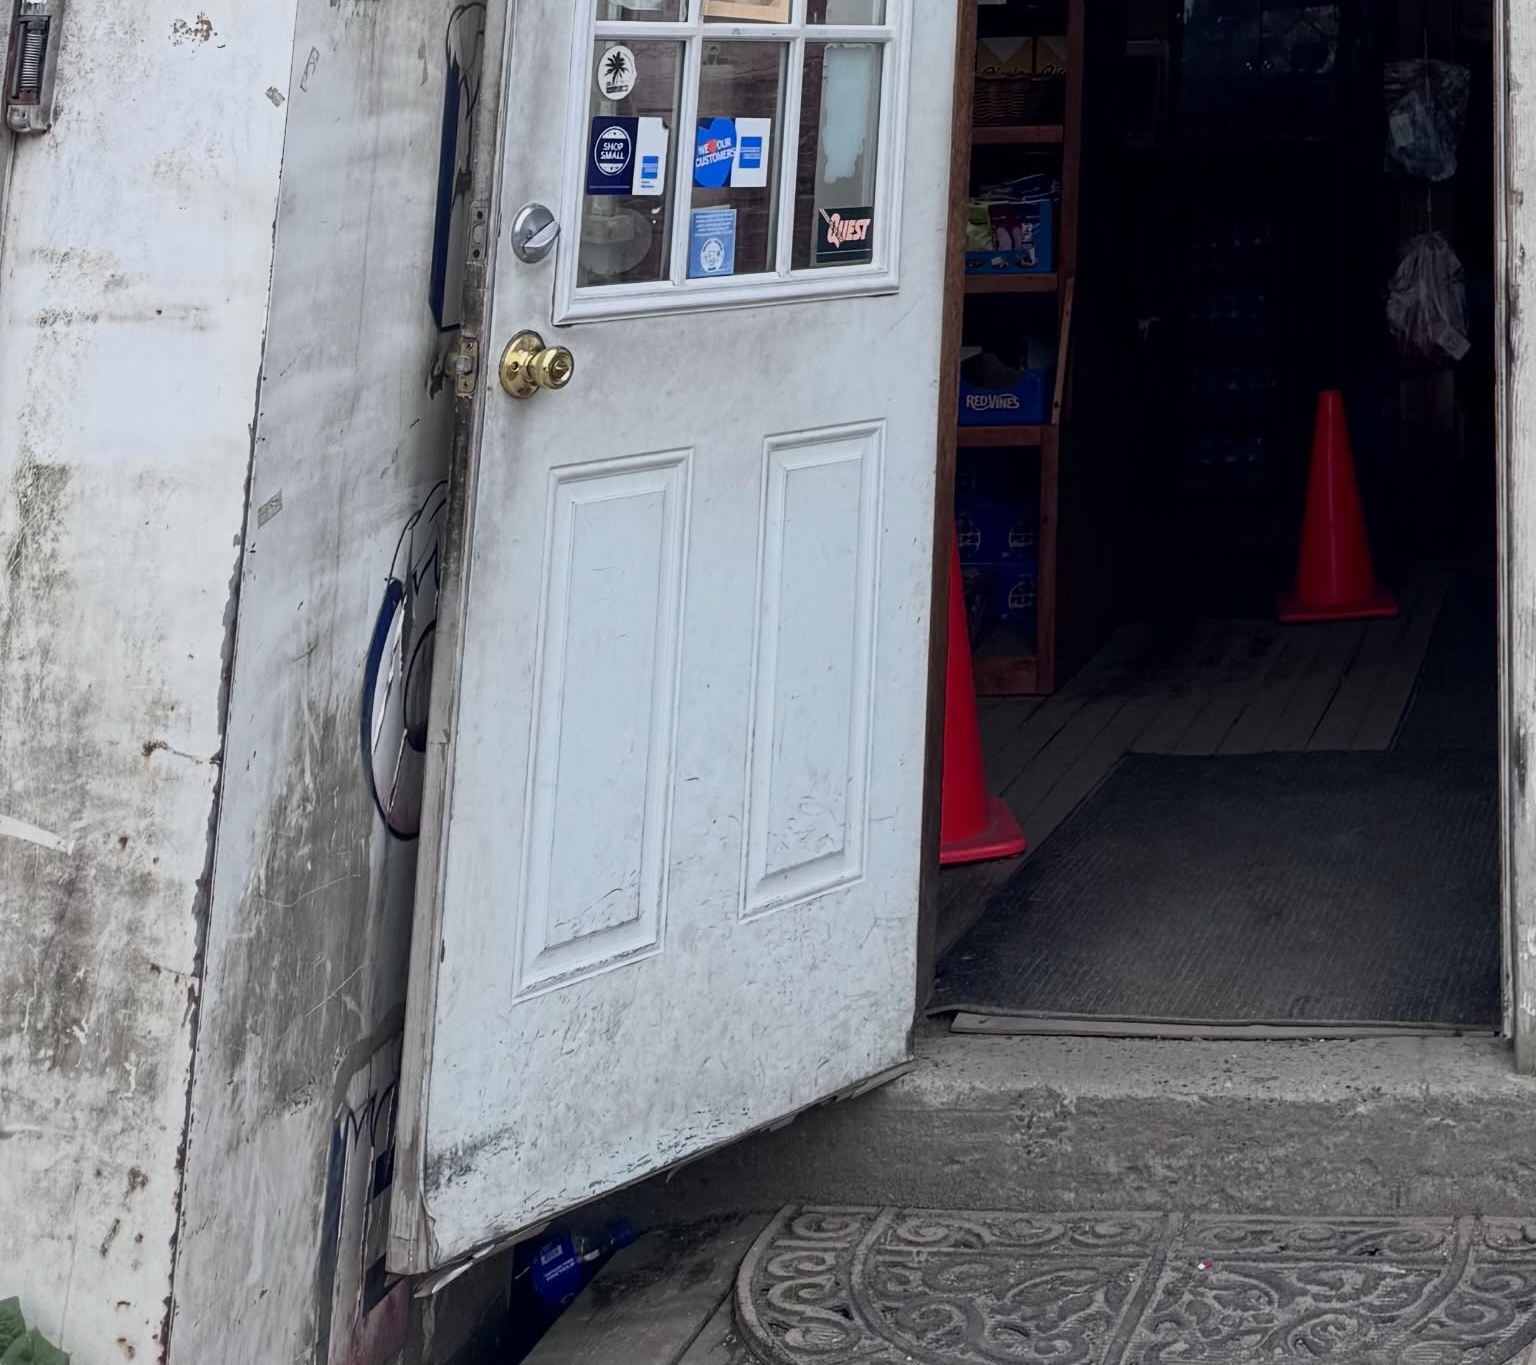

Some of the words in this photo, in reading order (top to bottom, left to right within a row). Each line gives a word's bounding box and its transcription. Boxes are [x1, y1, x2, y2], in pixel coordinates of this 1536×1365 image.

[602, 142, 624, 152] SHOP
[697, 142, 709, 155] WE
[716, 137, 732, 150] OUR
[600, 151, 625, 160] SMALL
[695, 146, 736, 168] CUSTOMERS
[827, 213, 872, 248] QUEST
